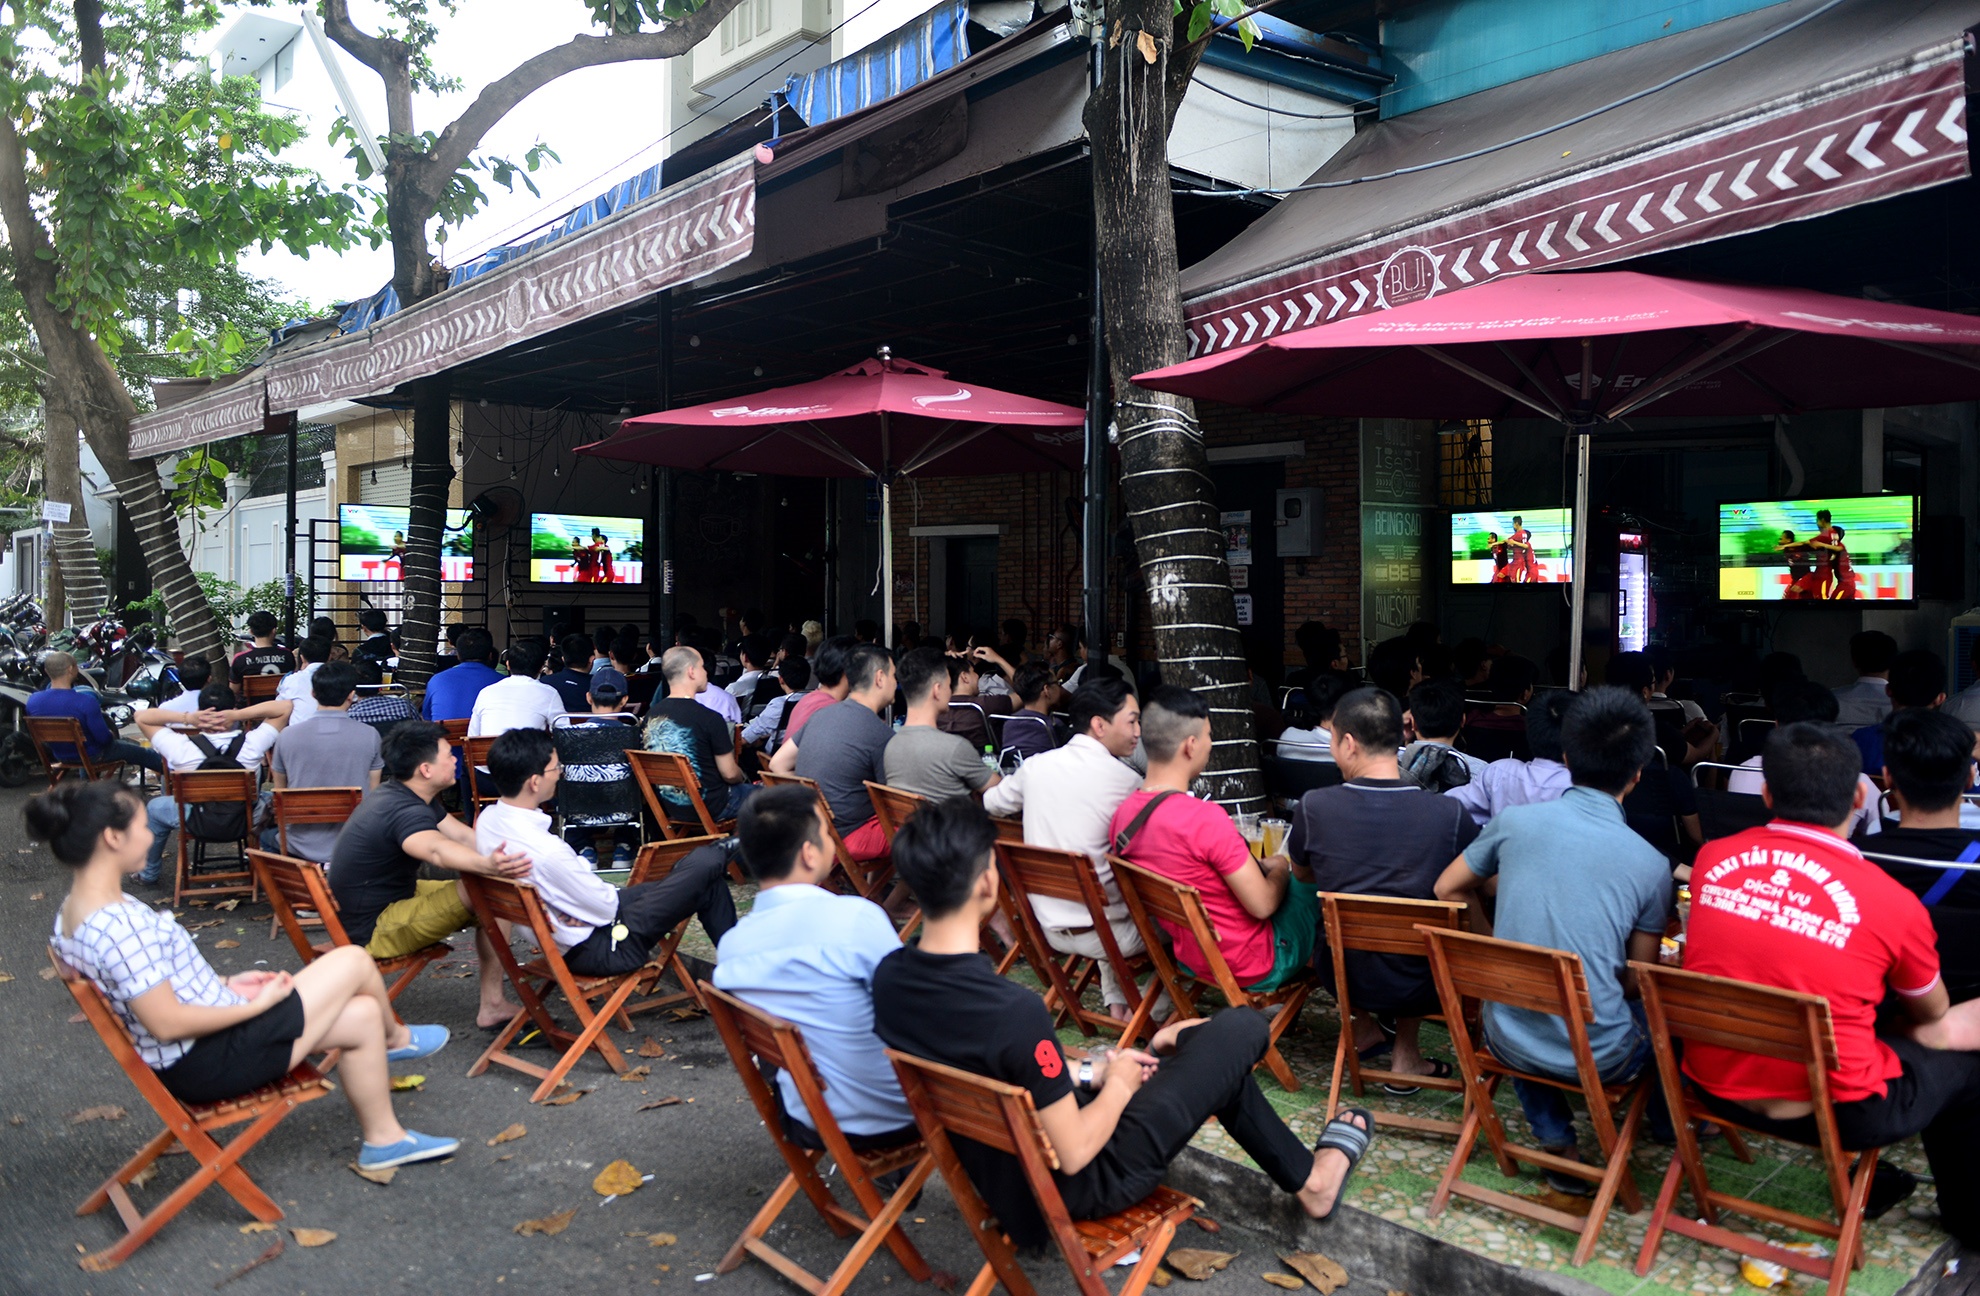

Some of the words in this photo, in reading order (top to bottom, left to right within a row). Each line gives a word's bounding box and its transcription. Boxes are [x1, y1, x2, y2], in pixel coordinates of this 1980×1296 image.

[1375, 510, 1403, 536] BEING
[1404, 512, 1421, 536] SAD
[1388, 564, 1409, 581] BE
[1375, 595, 1421, 626] AWESOME
[1704, 856, 1740, 883] TAXI
[1739, 845, 1768, 867] TẢI
[1771, 850, 1831, 884] THÀNH
[1823, 879, 1861, 925] HƯNG
[1743, 878, 1784, 898] DỊCH
[1787, 889, 1812, 907] VỤ
[1770, 869, 1792, 888] &
[1701, 883, 1750, 905] CHUYỂN
[1750, 896, 1780, 914] NHÀ
[1782, 905, 1823, 927] TRỌN
[1823, 919, 1852, 938] GÓI
